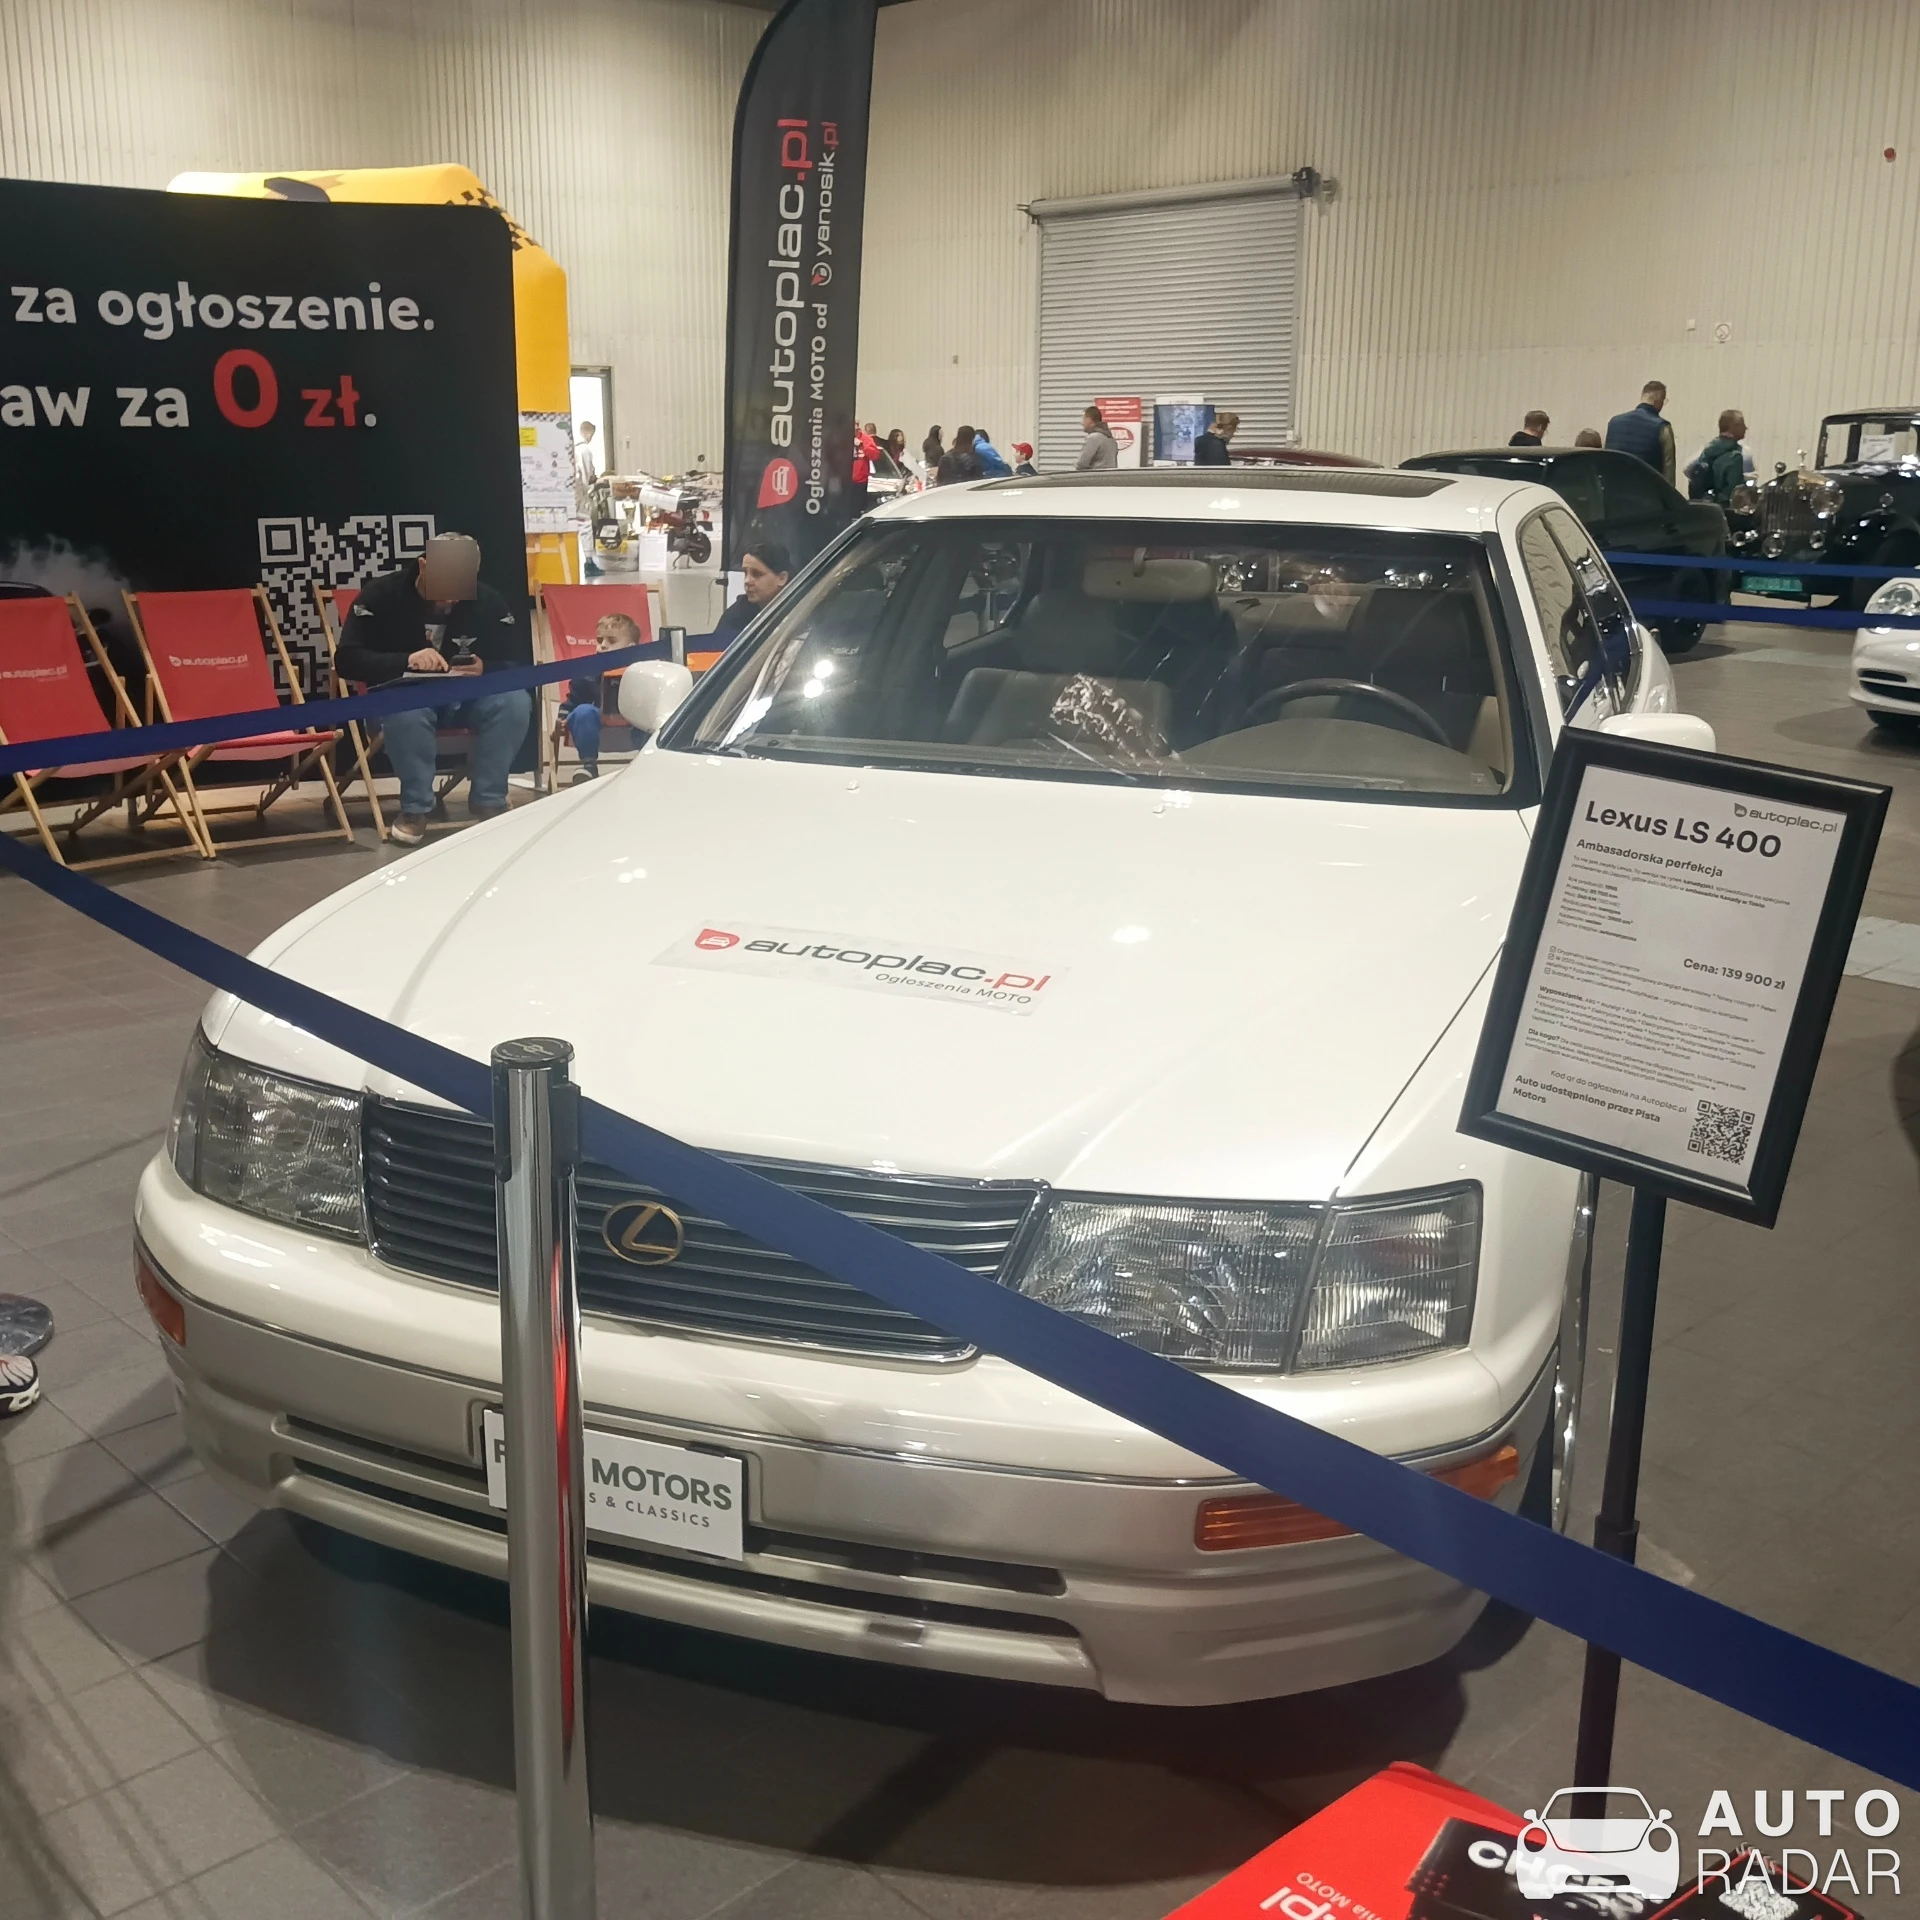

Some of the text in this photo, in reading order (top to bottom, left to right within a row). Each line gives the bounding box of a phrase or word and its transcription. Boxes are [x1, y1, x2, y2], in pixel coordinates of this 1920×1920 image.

[768, 118, 813, 447] autoplac.pl
[11, 280, 436, 340] za ogłoszenie.
[805, 122, 839, 514] Ogłoszenia MOTO od yanosik.pl
[116, 387, 190, 427] za
[213, 348, 278, 428] 0
[182, 653, 248, 666] autoplac.pl
[1585, 800, 1781, 857] Lexus LS 400
[1749, 809, 1837, 833] autoplac.pl
[1576, 838, 1722, 877] Ambasadorska perfekcja
[743, 936, 1052, 993] autoplac.pl
[1683, 958, 1785, 990] Cena: 139 900 zł
[874, 972, 1032, 1006] Ogłoszenia MOTO
[1527, 1027, 1538, 1035] Dla
[1539, 1031, 1560, 1040] kogo?
[1512, 1087, 1546, 1103] Motors
[1515, 1074, 1660, 1122] Auto udostępnione przez Pista
[1550, 1070, 1565, 1079] Kod
[1587, 1081, 1628, 1097] ogłoszenia
[1629, 1092, 1639, 1100] na
[1640, 1095, 1687, 1112] Autoplac.pl
[591, 1457, 732, 1511] MOTORS
[626, 1499, 711, 1528] CLASSICS
[1296, 1872, 1352, 1909] MOTO
